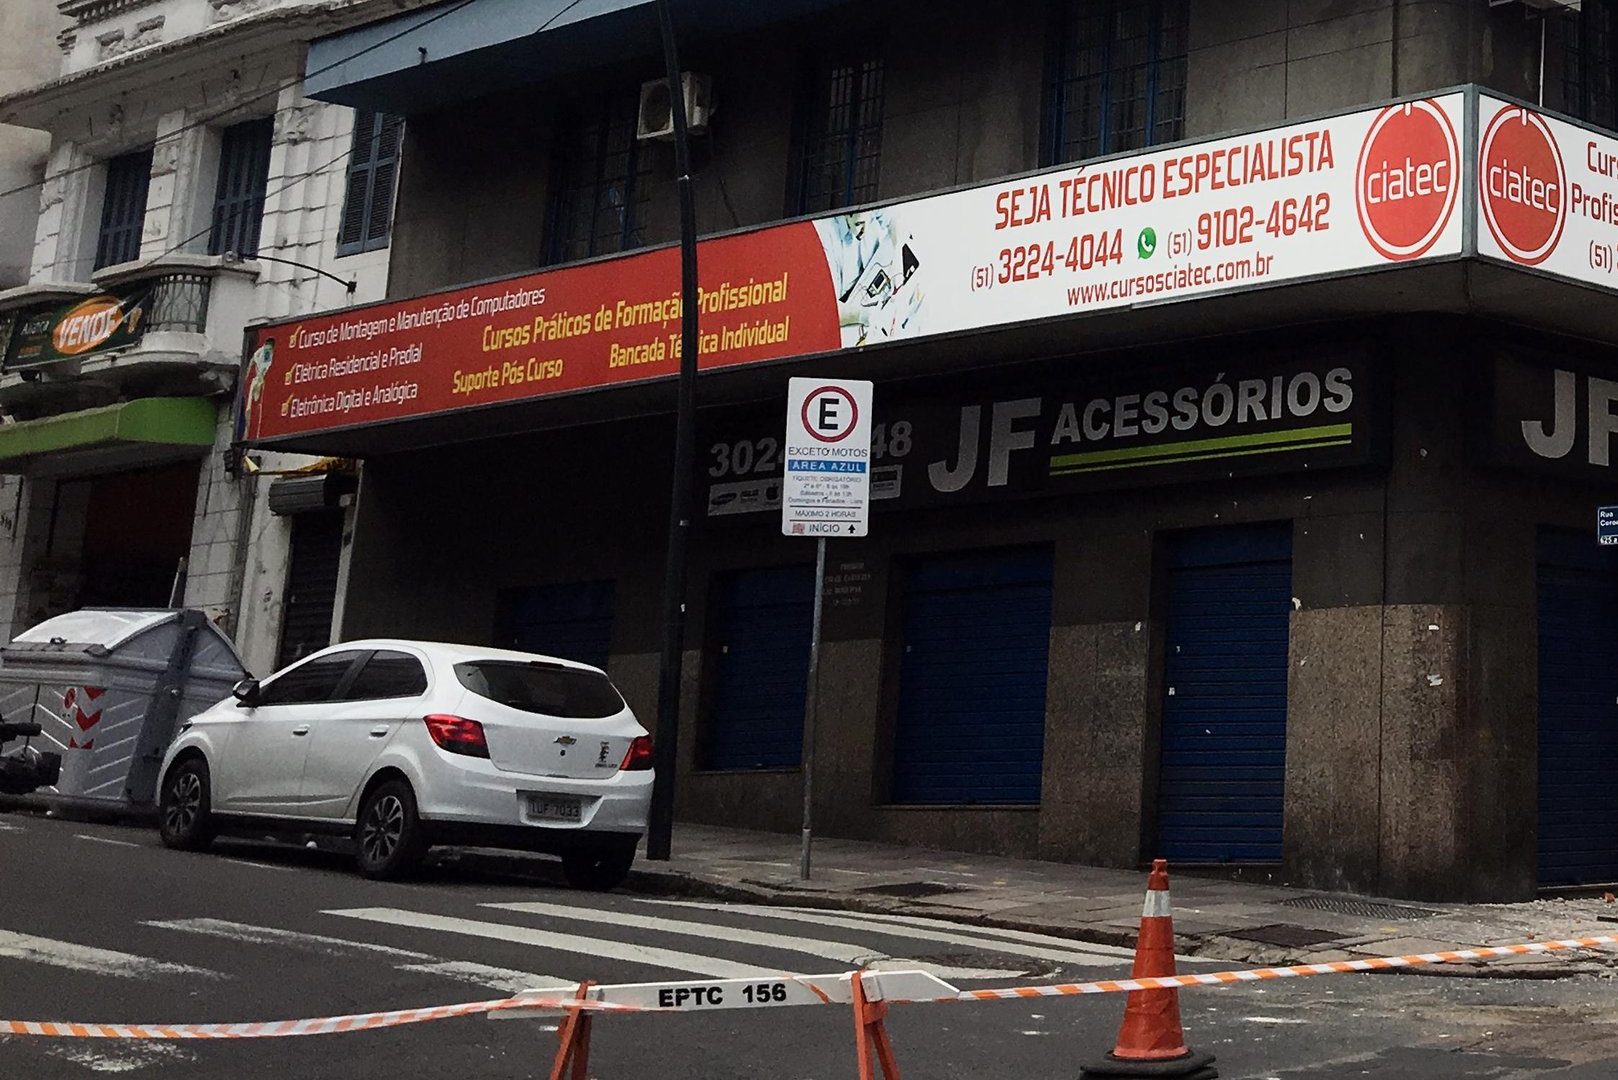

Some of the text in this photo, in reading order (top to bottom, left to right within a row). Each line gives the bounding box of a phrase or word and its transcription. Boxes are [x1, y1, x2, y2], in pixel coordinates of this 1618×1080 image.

[995, 129, 1335, 230] SEJA TÉCNICO ESPECIALISTA
[1366, 154, 1448, 205] ciatec
[1489, 158, 1557, 213] ciatec
[970, 194, 1331, 292] (51) 3224-4044 (51) 9102-4642
[1589, 240, 1613, 274] (51)
[1066, 253, 1274, 306] www.cursosciatec.com.br
[298, 287, 546, 349] Curso de Montagem e Manutenção de Computadores
[482, 323, 531, 352] Cursos
[533, 312, 591, 343] Práticos
[594, 305, 612, 332] de
[615, 291, 683, 331] Formaçã
[294, 360, 328, 383] Elétrica
[329, 350, 381, 379] Residencial
[388, 342, 423, 365] Predial
[609, 315, 789, 368] Bancada Téica Individual
[290, 381, 418, 418] Eletrônica Digital e Analógica
[452, 357, 564, 396] Suporte Pós Curso
[819, 398, 840, 430] E
[928, 395, 1043, 493] JF
[1050, 366, 1355, 446] ACESSÓRIOS
[788, 447, 868, 458] EXCETO MOTOS
[831, 462, 862, 472] AZUL
[809, 523, 840, 533] INÍCIO
[658, 982, 788, 1008] EPTC 156
